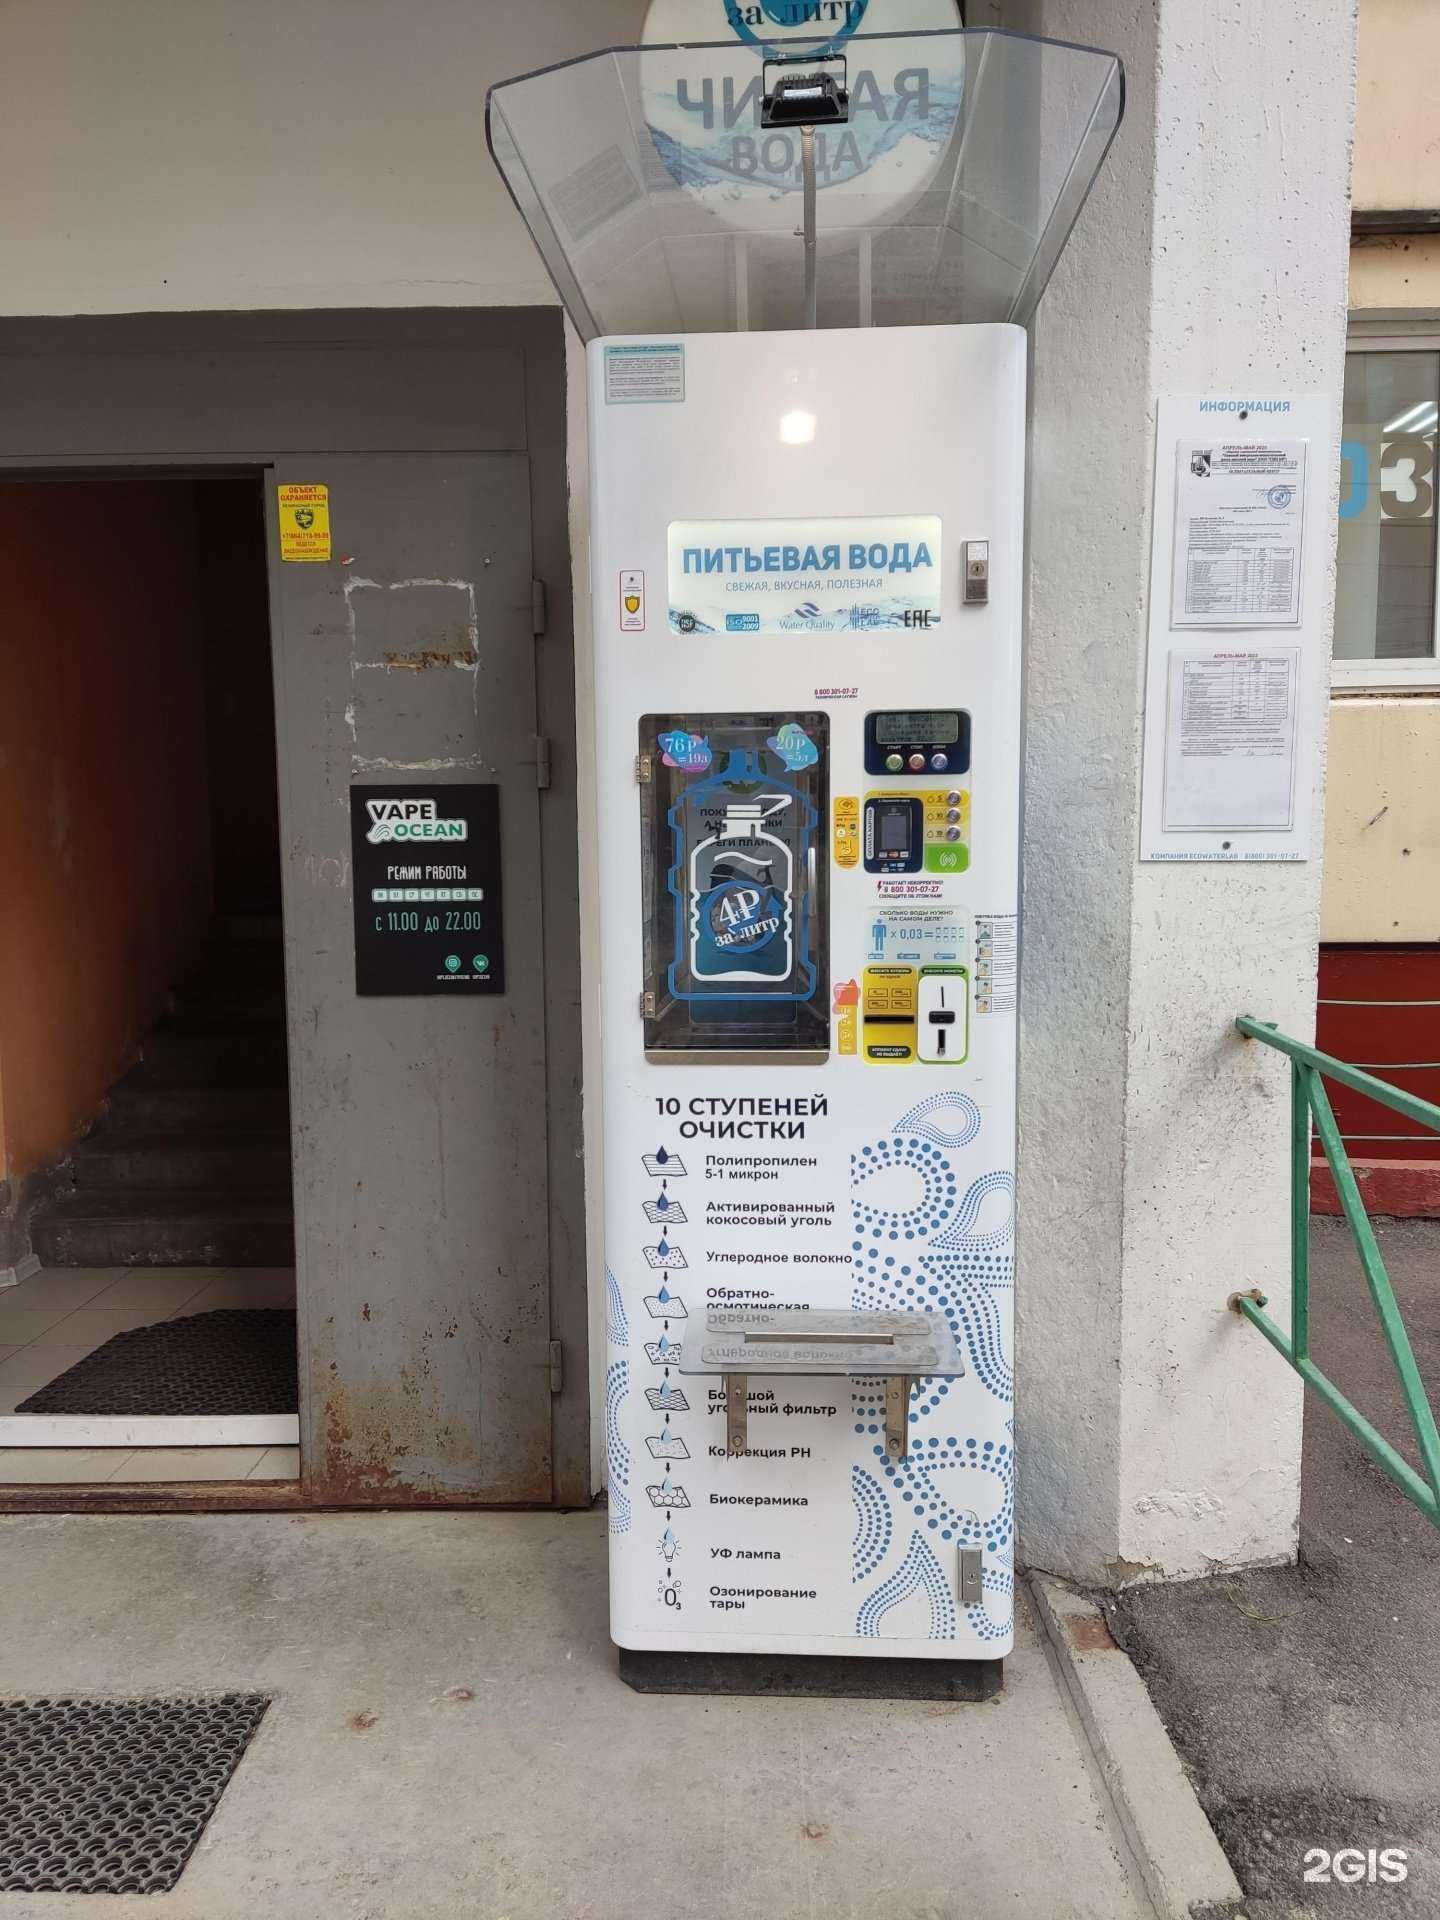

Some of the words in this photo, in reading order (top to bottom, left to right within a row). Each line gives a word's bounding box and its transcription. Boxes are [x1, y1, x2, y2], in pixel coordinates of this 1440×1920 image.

[728, 5, 764, 26] за
[780, 1, 862, 28] литр
[676, 67, 929, 129] ЧИАЯ
[732, 131, 864, 183] ВОДА
[1200, 401, 1290, 413] ИНФОРМАЦИЯ
[682, 544, 841, 574] ПИТЬЕВАЯ
[849, 542, 933, 573] ВОДА
[726, 582, 772, 593] СВЕЖАЯ,
[774, 580, 824, 592] ВКУСНАЯ,
[827, 578, 882, 590] ПОЛЕЗНАЯ
[779, 619, 804, 630] Water
[806, 618, 834, 631] Quality
[665, 738, 684, 752] 76
[776, 738, 793, 750] 20
[371, 804, 432, 820] VAPE
[394, 824, 463, 836] OCEAN
[387, 866, 422, 880] РЕЖИМ
[426, 865, 466, 880] РАБОТЫ
[387, 912, 418, 931] 11.00
[445, 912, 481, 931] 22.00
[714, 933, 734, 947] за
[740, 917, 779, 940] литр
[655, 1098, 681, 1115] 10
[689, 1094, 828, 1116] СТУПЕНЕЙ
[679, 1121, 805, 1139] ОЧИСТКИ
[706, 1155, 817, 1168] Полипропилен
[705, 1169, 723, 1179] 5-1
[729, 1170, 778, 1182] микрон
[706, 1202, 835, 1214] Активированный
[707, 1214, 786, 1226] кокосовый
[791, 1216, 832, 1227] уголь
[706, 1251, 788, 1264] Углеродное
[794, 1254, 852, 1264] волокно
[706, 1288, 775, 1300] Обратно-
[708, 1389, 775, 1401] Бошой
[708, 1402, 778, 1415] угоный
[783, 1403, 837, 1416] фильтр
[708, 1447, 786, 1460] Коррекция
[710, 1494, 808, 1507] Биокерамика
[710, 1548, 732, 1559] УФ
[736, 1550, 780, 1561] лампа
[710, 1586, 816, 1599] Озонирование
[710, 1600, 745, 1611] тары
